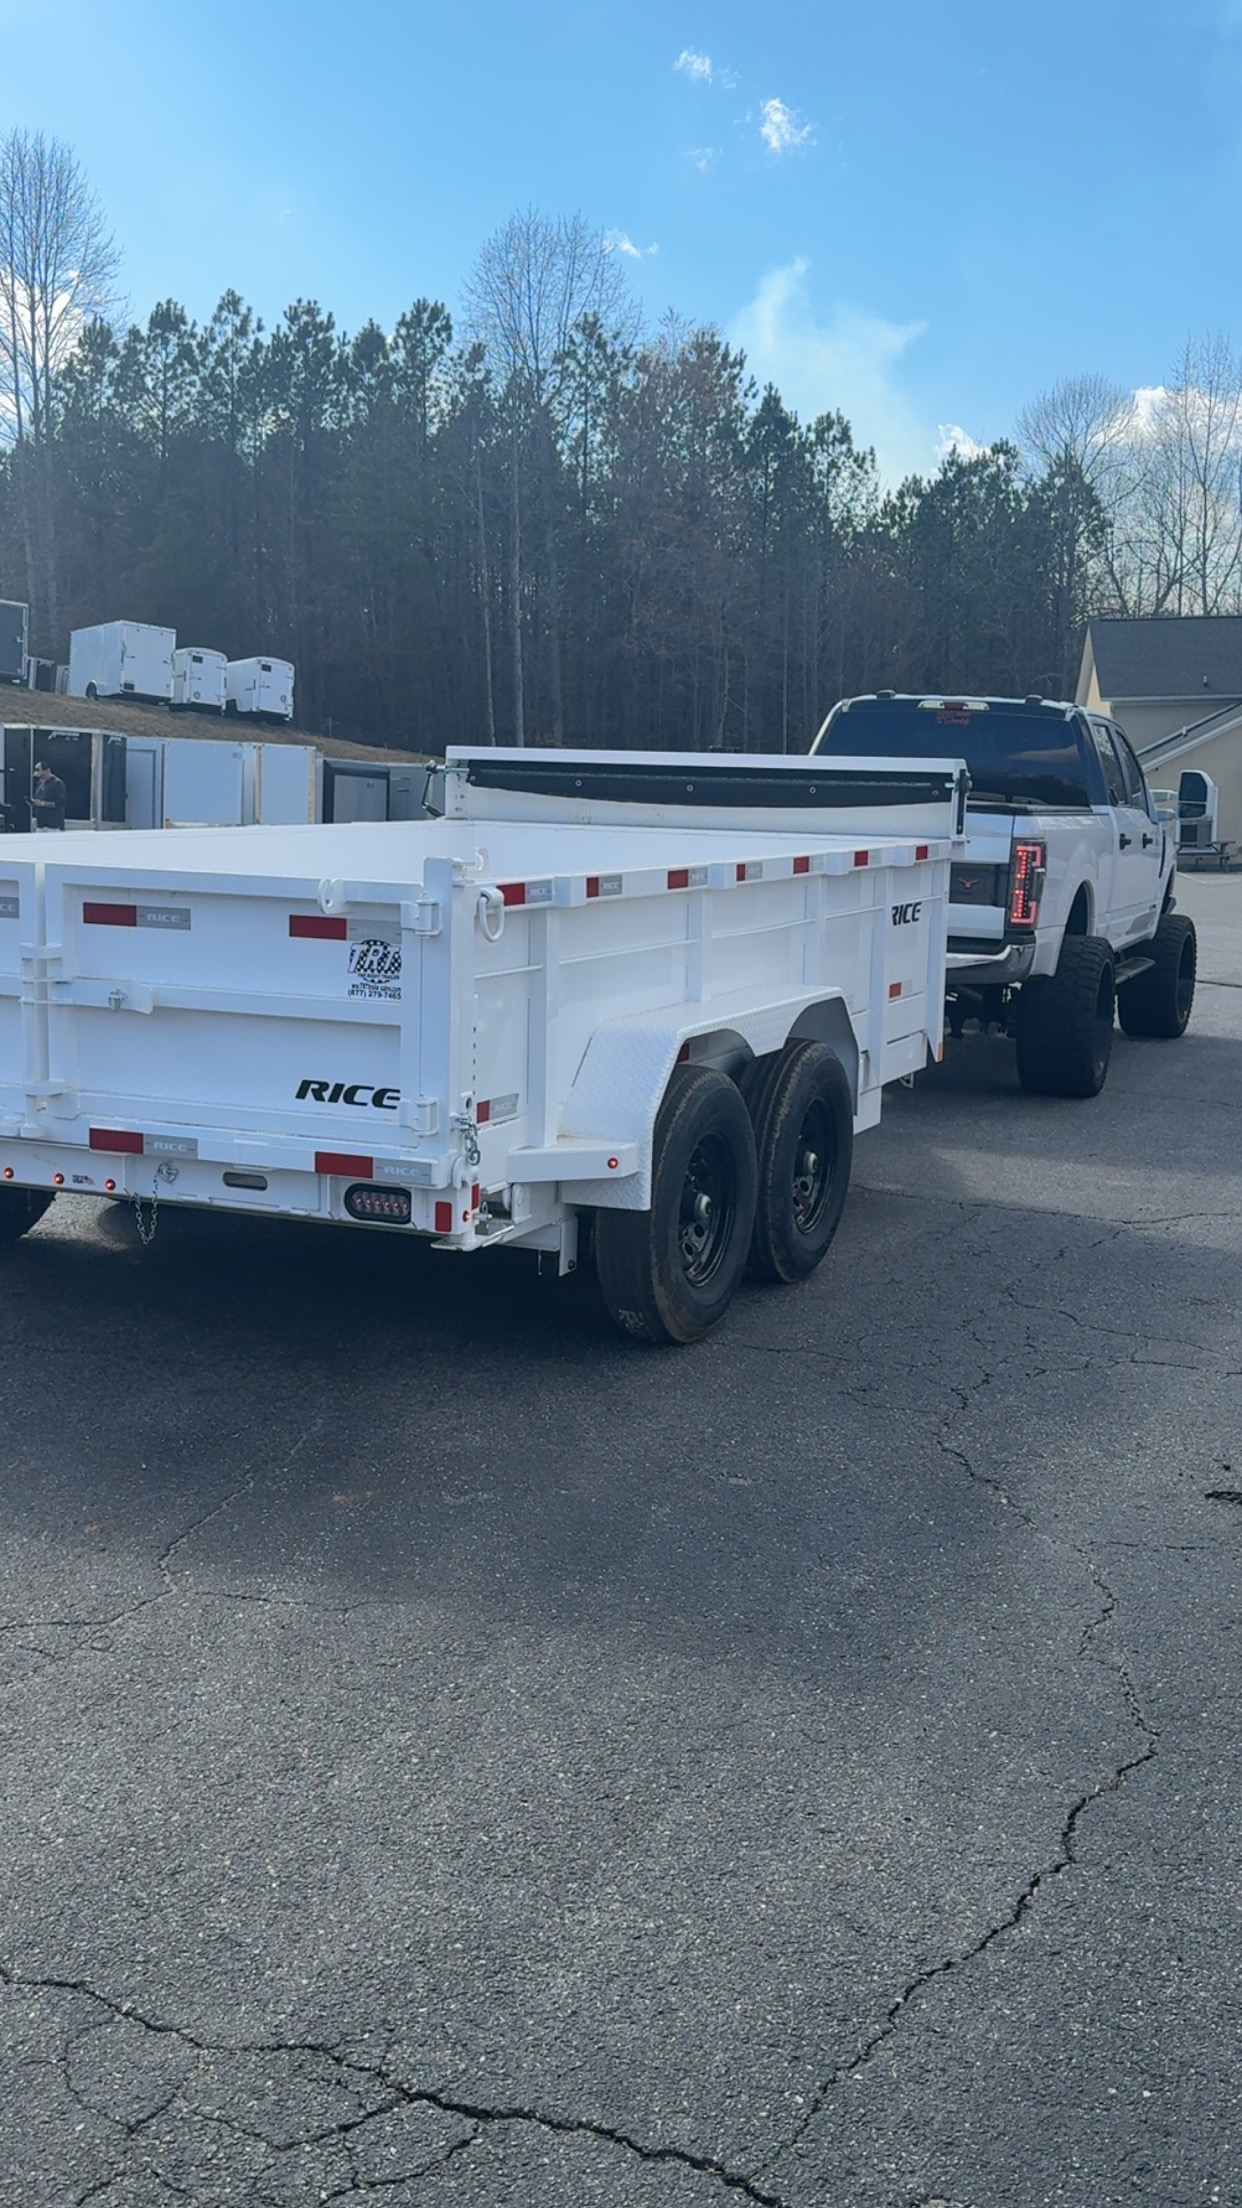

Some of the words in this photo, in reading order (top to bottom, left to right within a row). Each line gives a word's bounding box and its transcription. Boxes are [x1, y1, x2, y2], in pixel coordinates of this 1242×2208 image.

[147, 912, 181, 924] RICE
[348, 943, 401, 974] TRT
[295, 1079, 401, 1110] RICE
[153, 1140, 188, 1153] RICE
[383, 1164, 421, 1178] RICE
